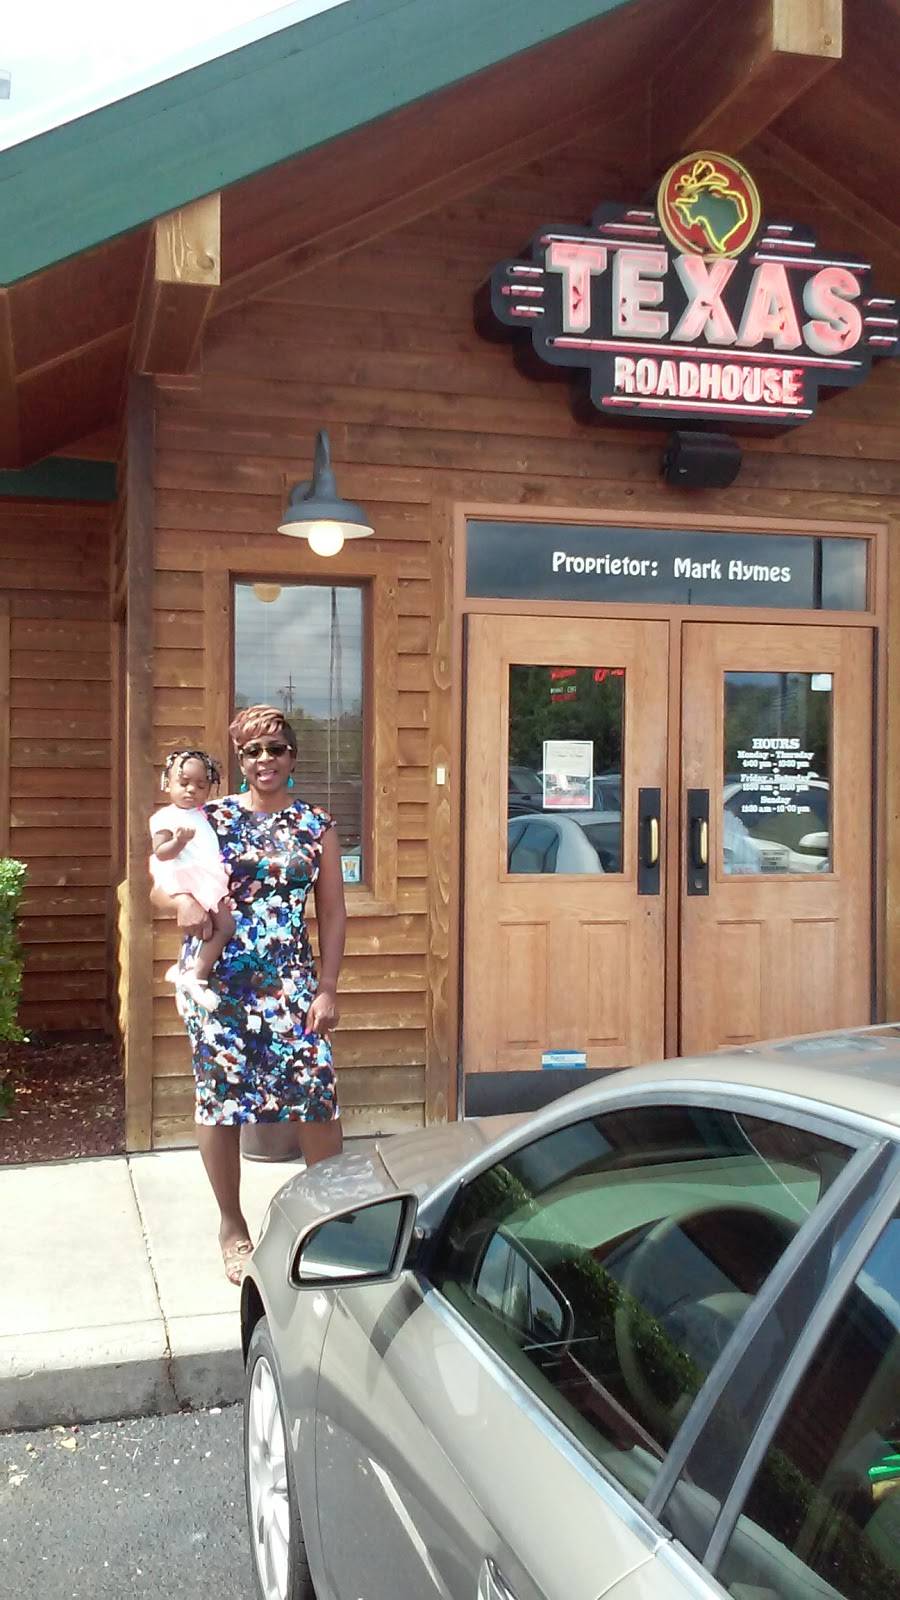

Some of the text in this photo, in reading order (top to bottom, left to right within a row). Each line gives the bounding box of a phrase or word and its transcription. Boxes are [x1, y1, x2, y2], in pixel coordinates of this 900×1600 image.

[546, 242, 862, 355] TEXAS
[614, 357, 803, 405] ROADHOUSE
[552, 551, 792, 582] Proprietor: Mark Hymes
[752, 738, 800, 749] HOURS
[737, 750, 770, 760] Monday
[775, 750, 815, 760] Thursday
[759, 761, 772, 769] pm
[797, 761, 810, 769] pm
[760, 796, 792, 805] Sunday
